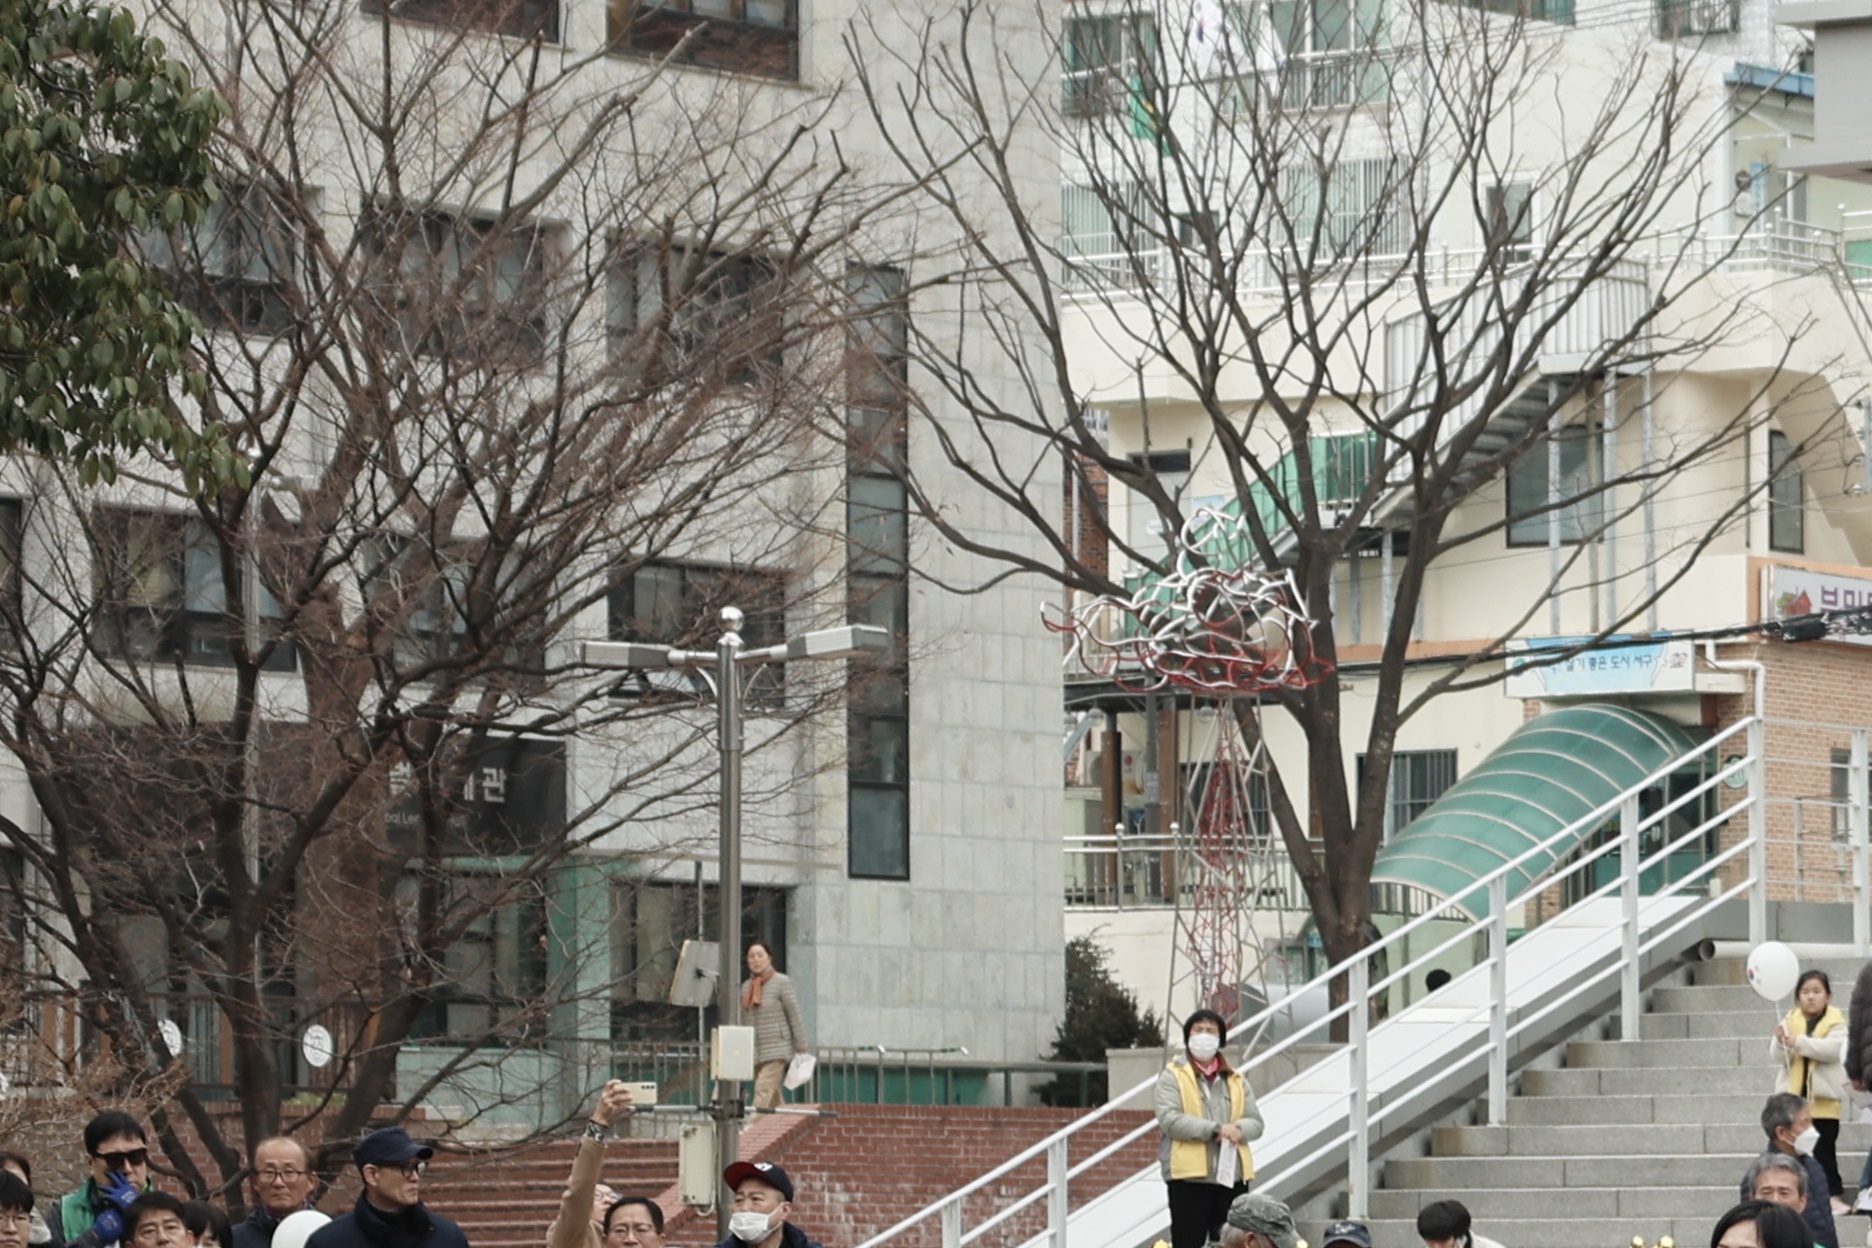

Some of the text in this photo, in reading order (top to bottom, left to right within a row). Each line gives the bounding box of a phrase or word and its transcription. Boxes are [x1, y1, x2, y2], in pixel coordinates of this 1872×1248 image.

[1589, 656, 1608, 671] 좋은
[1610, 655, 1630, 669] 도시
[1633, 654, 1653, 669] 서구
